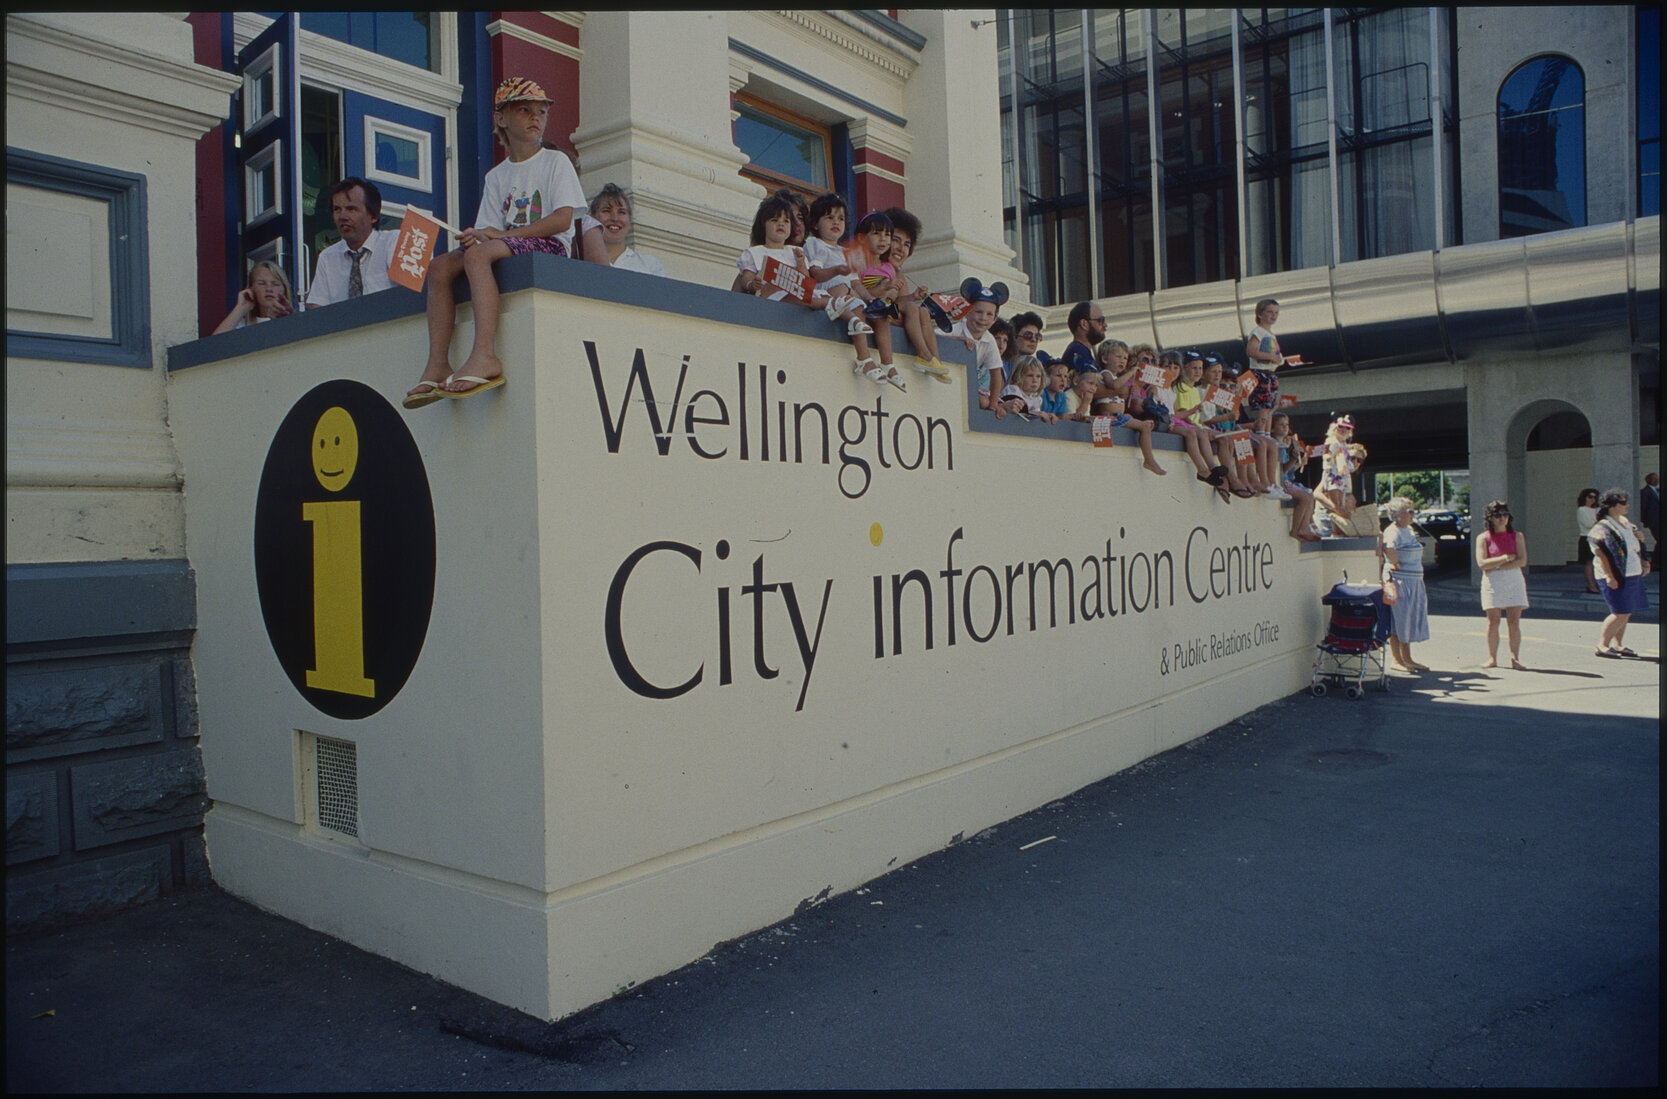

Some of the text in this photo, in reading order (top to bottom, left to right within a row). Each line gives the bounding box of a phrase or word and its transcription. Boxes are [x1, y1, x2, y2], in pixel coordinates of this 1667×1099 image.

[400, 225, 429, 279] Post
[773, 262, 806, 287] JUST
[770, 275, 806, 301] JUICE
[582, 340, 954, 500] Wellington
[604, 521, 1274, 713] City information Centre
[1160, 620, 1279, 676] & Public Relations Office
